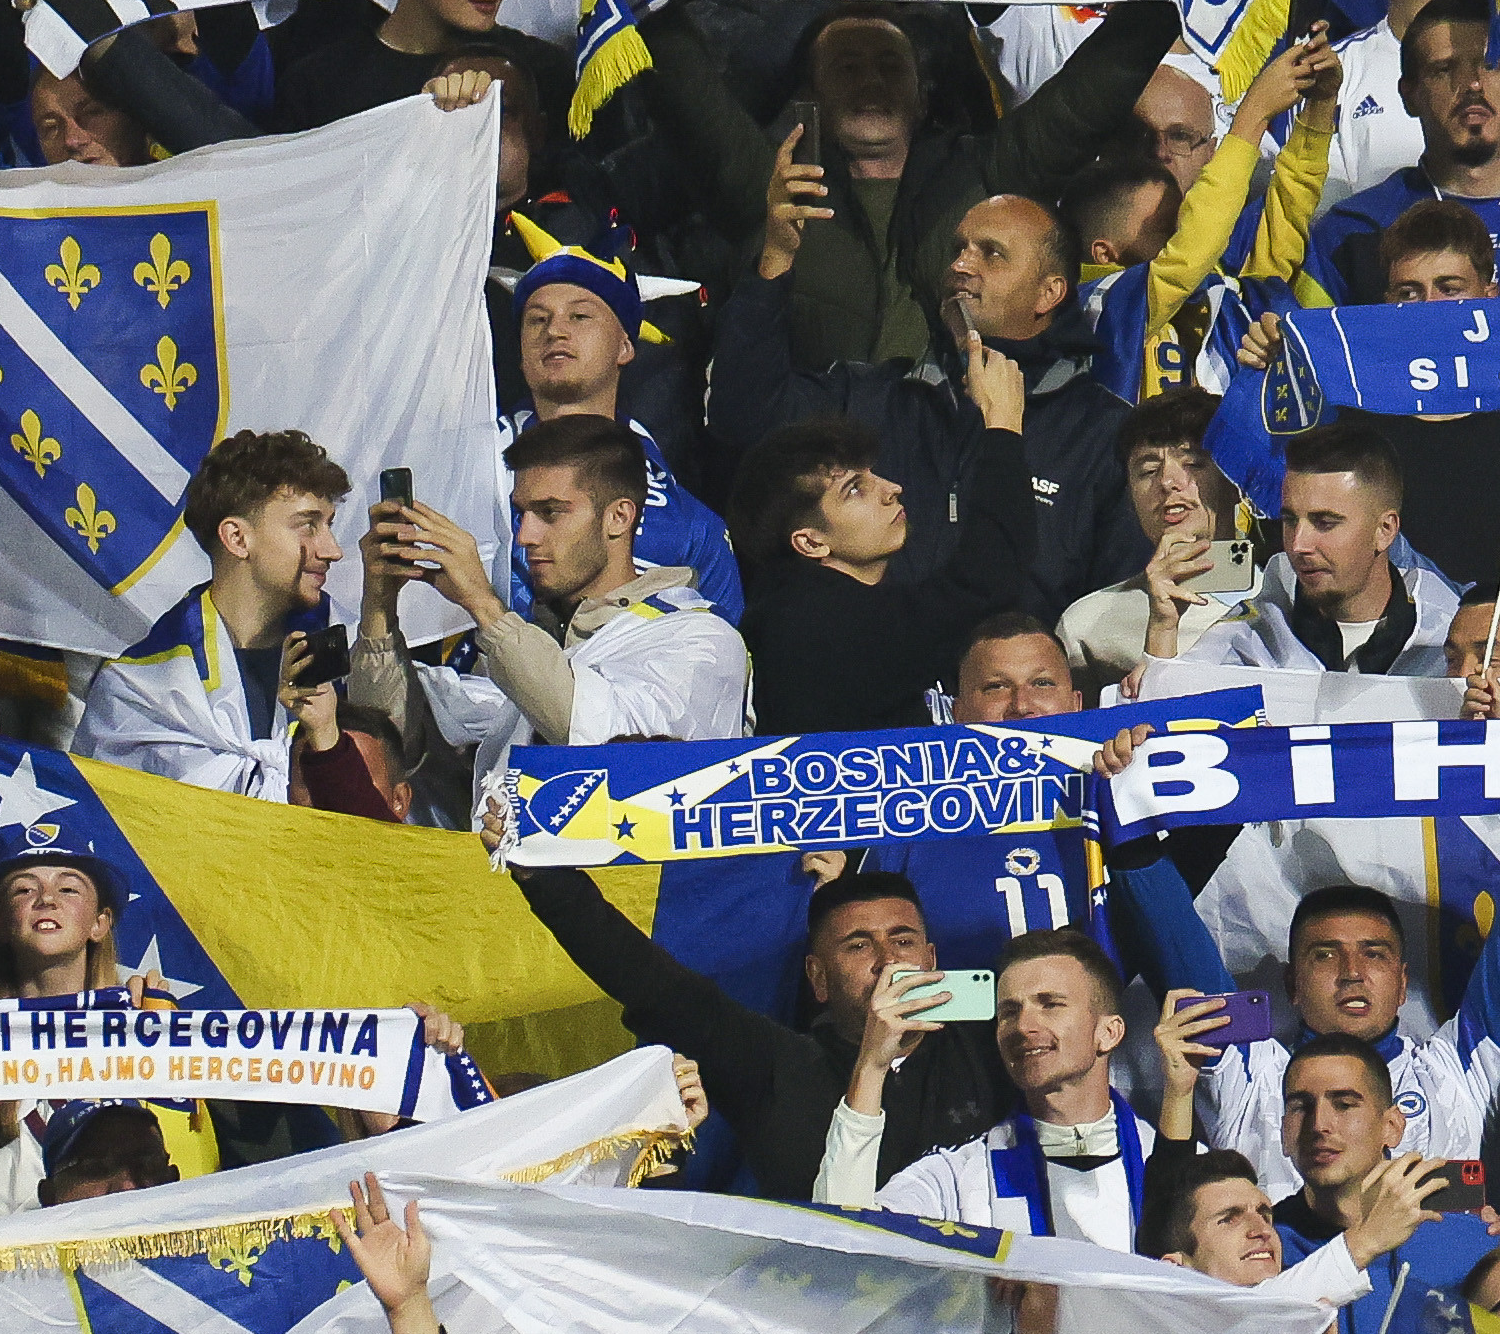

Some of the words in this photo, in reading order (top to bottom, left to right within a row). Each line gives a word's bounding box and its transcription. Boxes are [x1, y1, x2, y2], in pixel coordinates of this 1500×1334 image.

[0, 1013, 10, 1051] I
[31, 1009, 379, 1059] HERCEGOVINA
[169, 1056, 375, 1090] HERCEGOVINO
